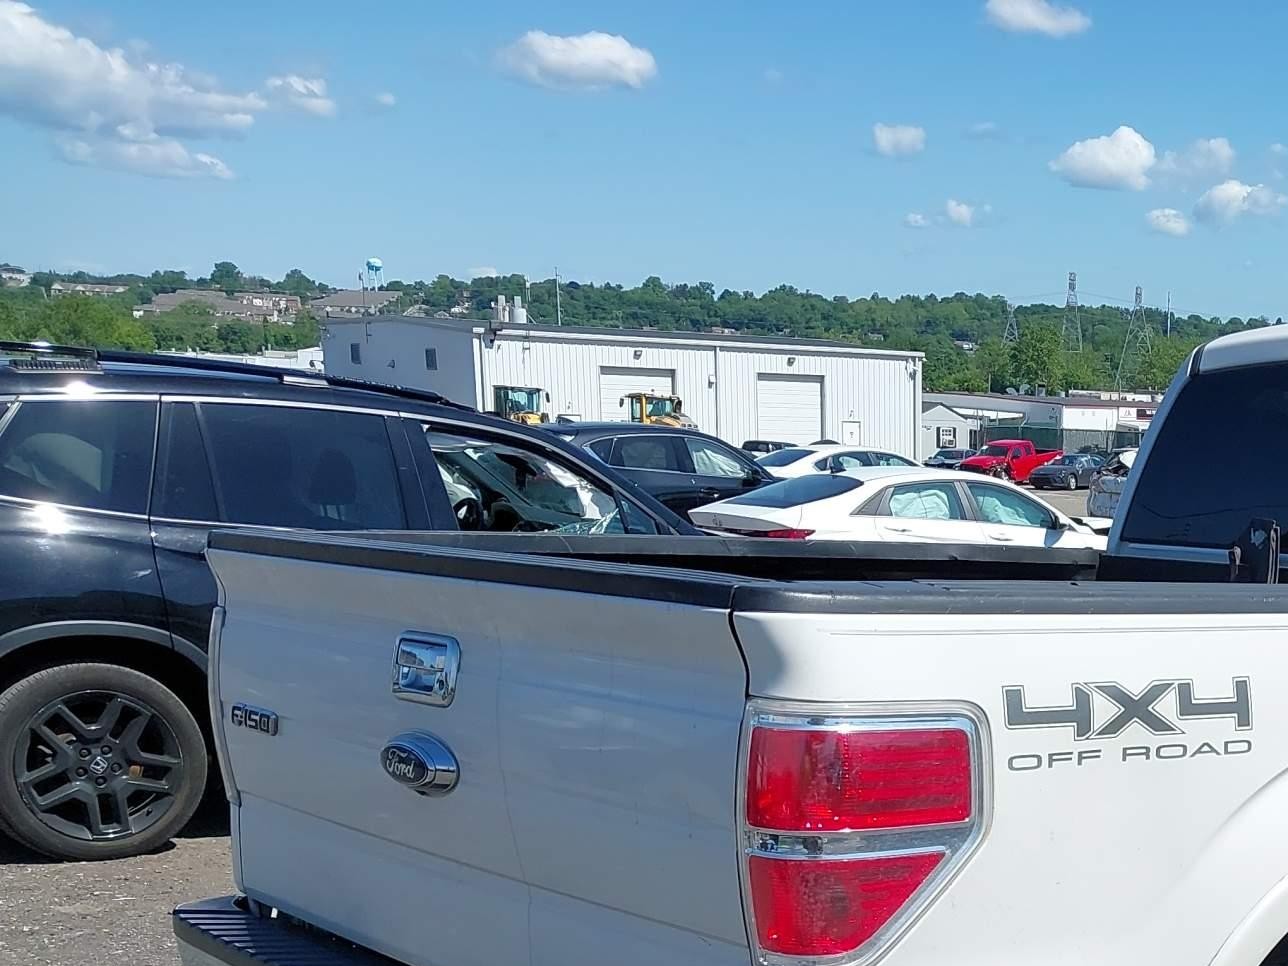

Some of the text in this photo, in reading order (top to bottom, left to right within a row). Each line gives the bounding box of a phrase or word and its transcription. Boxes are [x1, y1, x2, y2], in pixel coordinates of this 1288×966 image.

[386, 748, 416, 779] Ford
[1007, 739, 1252, 771] OFF ROAD
